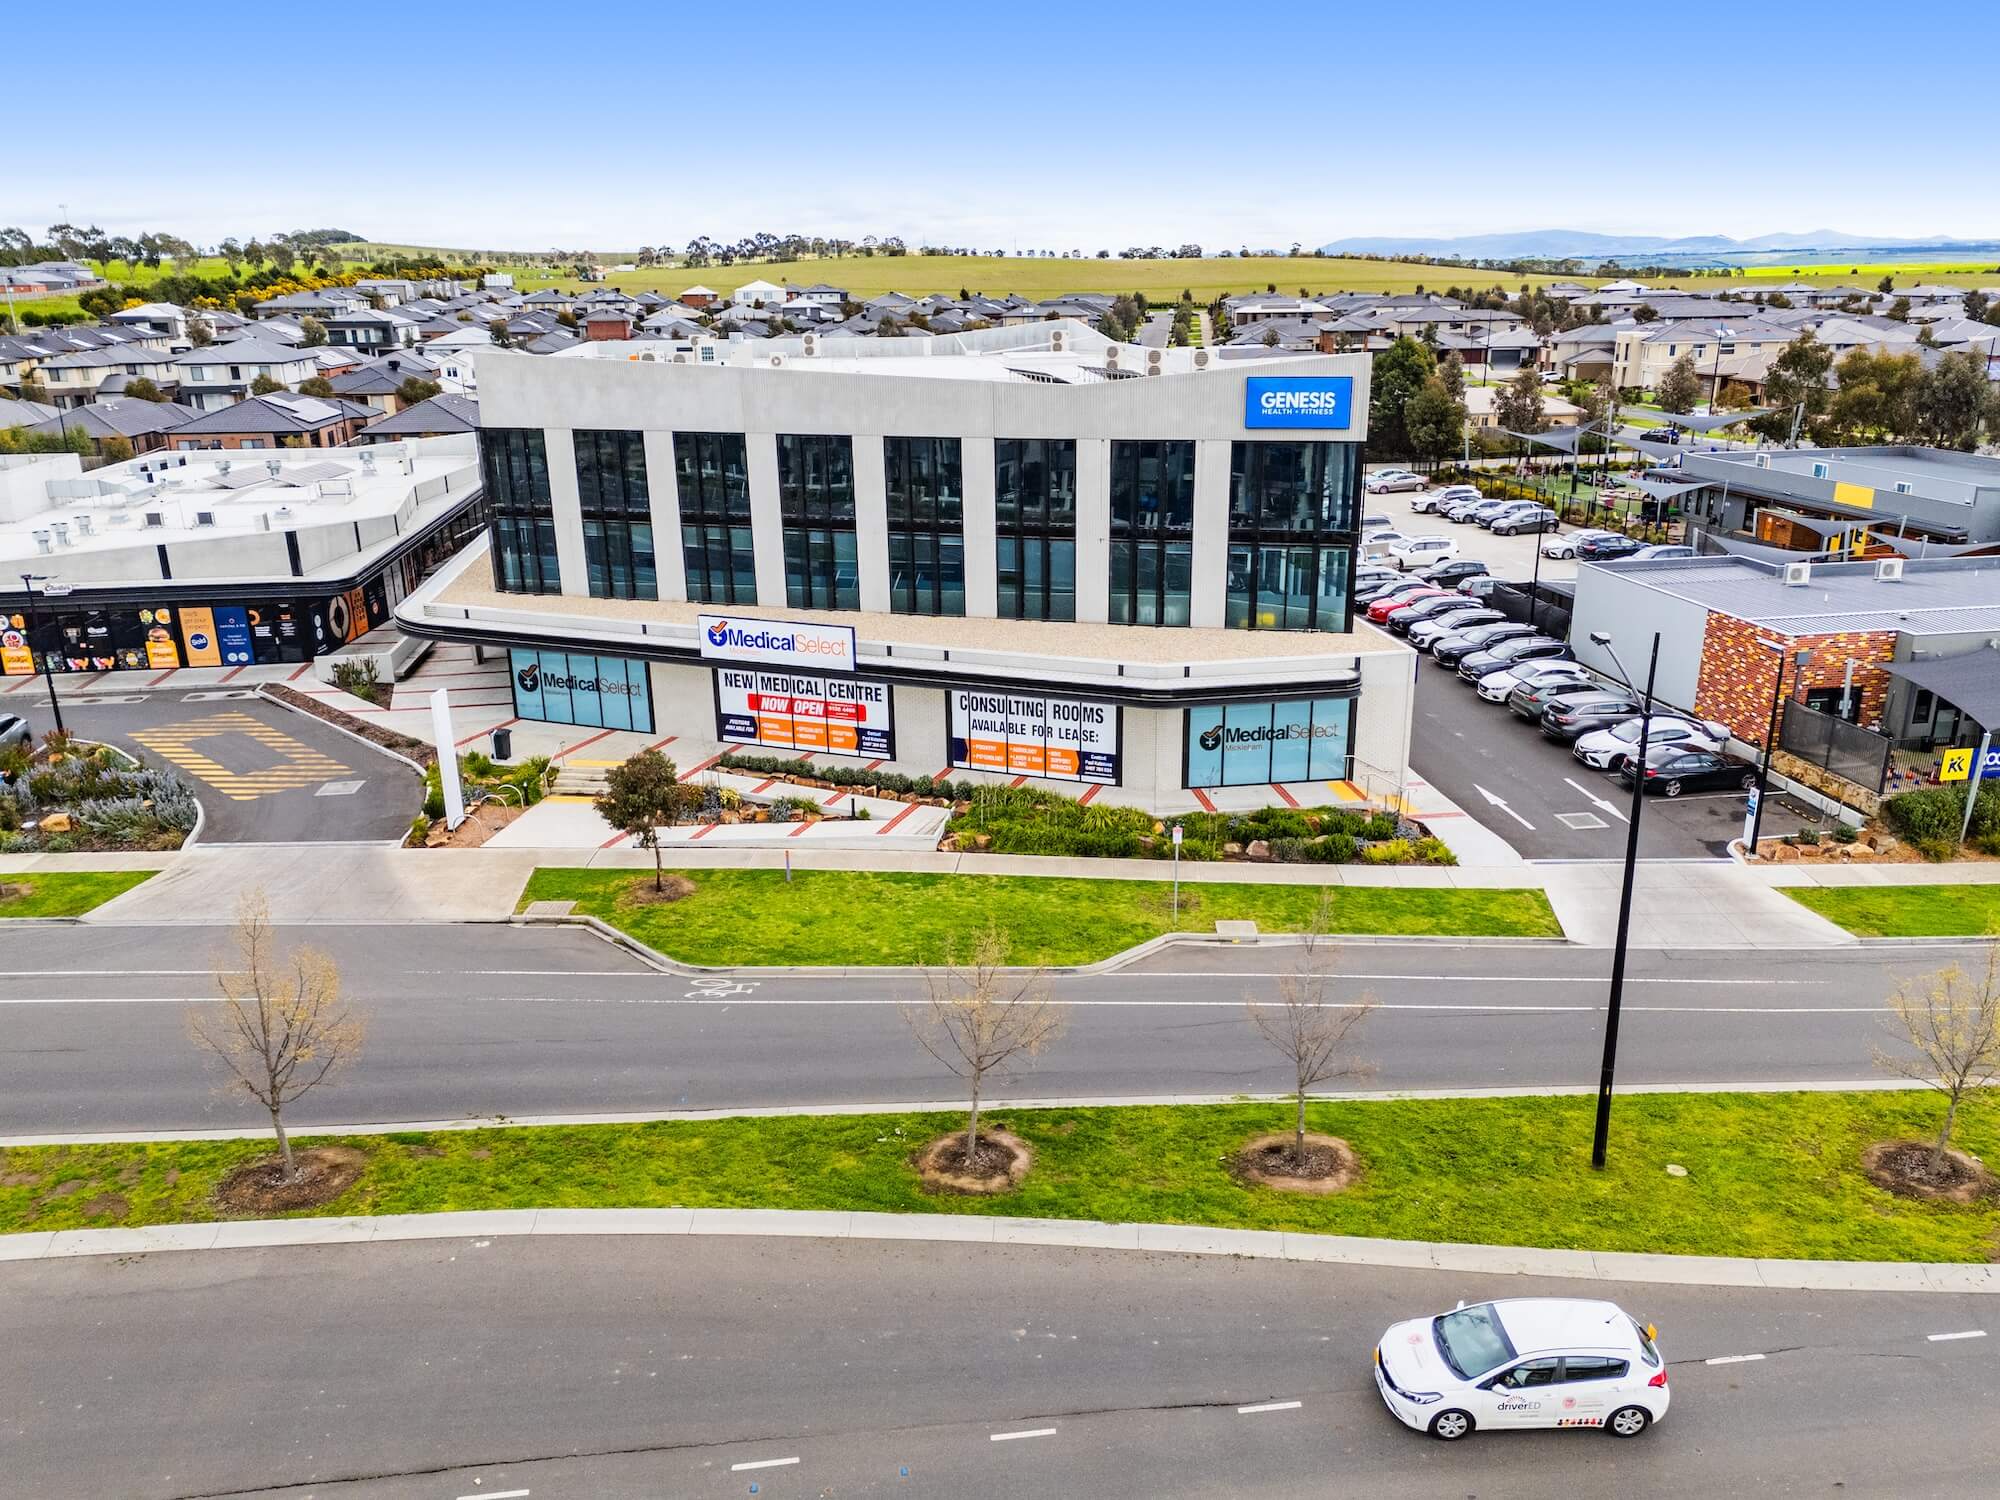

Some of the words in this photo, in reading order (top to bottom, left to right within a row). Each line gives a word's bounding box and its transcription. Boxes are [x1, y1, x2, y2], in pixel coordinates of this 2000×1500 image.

[1260, 392, 1336, 408] GENESIS
[728, 628, 846, 656] MedicalSelect
[543, 672, 642, 696] MedicalSelect
[724, 672, 753, 690] NEW
[760, 676, 822, 696] MEDICAL
[829, 682, 882, 702] CENTRE
[760, 696, 789, 712] NOW
[794, 700, 824, 716] OPEN
[960, 695, 1044, 718] CONSULTING
[1053, 704, 1104, 724] ROOMS
[972, 719, 1026, 736] AVAILABLE
[1032, 724, 1053, 738] FOR
[1058, 727, 1099, 743] LEASE:
[1226, 723, 1338, 744] MedicalSelect
[1497, 1402, 1542, 1411] driverED
